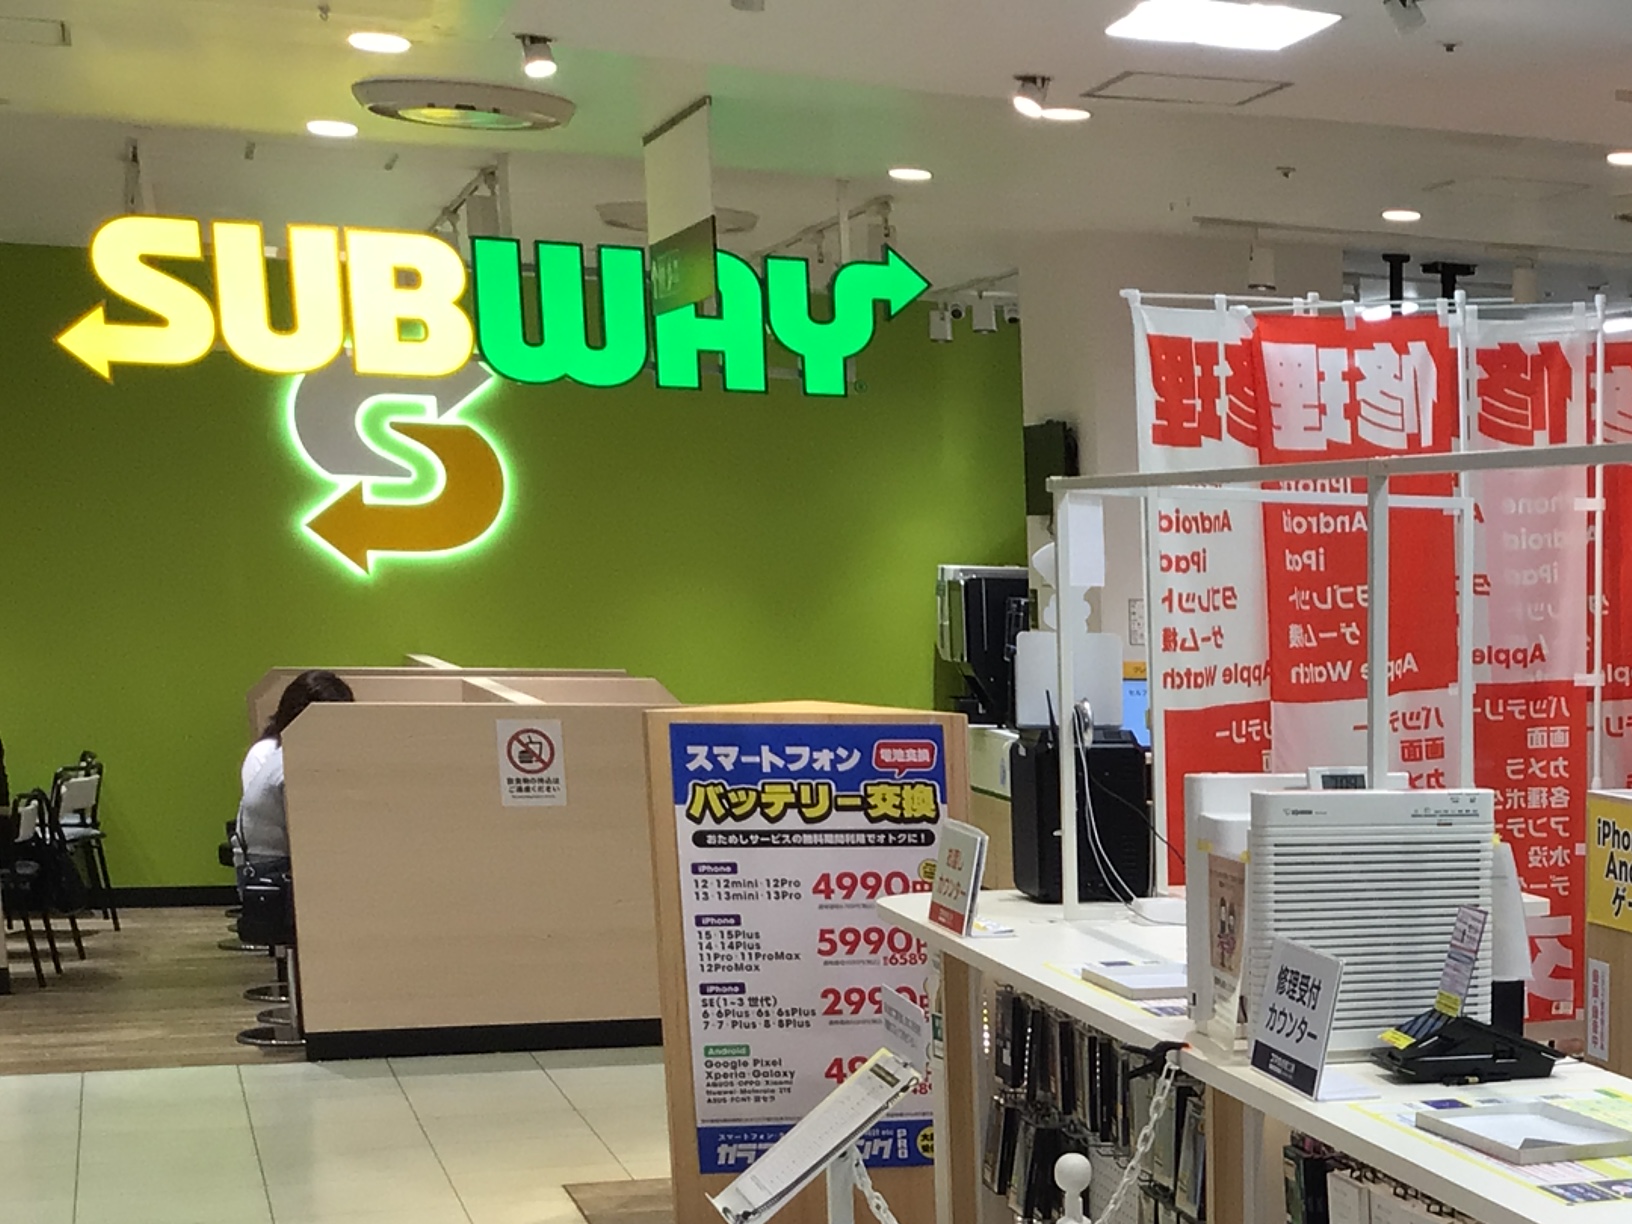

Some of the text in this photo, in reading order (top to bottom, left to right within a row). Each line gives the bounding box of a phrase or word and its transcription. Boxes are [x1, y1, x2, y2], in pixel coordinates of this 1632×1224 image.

[55, 216, 931, 397] SUBWAY
[685, 744, 862, 773] スマートフォン
[687, 781, 939, 823] バッテリー交換
[820, 985, 930, 1016] 299
[1275, 964, 1323, 1011] 修理受付
[1265, 1001, 1319, 1045] カウンター
[704, 1058, 782, 1070] Google Pixel
